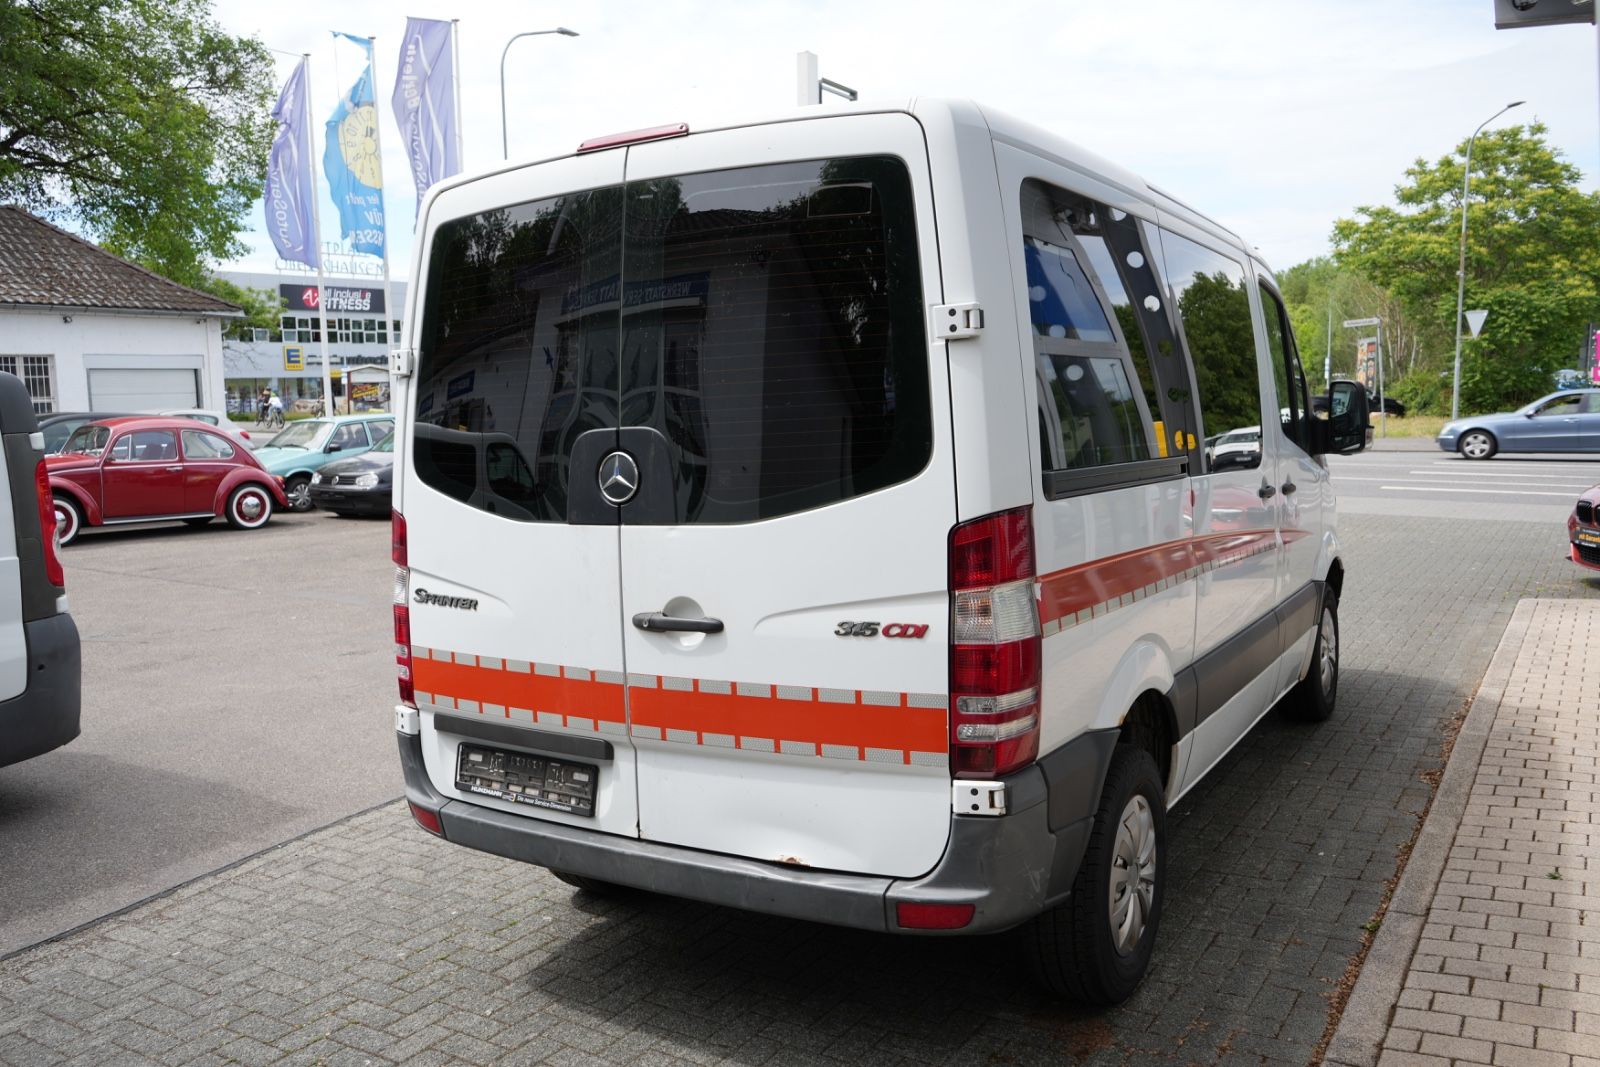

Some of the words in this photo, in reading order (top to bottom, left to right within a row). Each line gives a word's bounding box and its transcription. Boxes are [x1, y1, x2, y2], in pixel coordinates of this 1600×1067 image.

[287, 349, 300, 363] E
[413, 588, 479, 611] SPRINTER
[834, 621, 880, 637] 315
[881, 623, 929, 639] CDI
